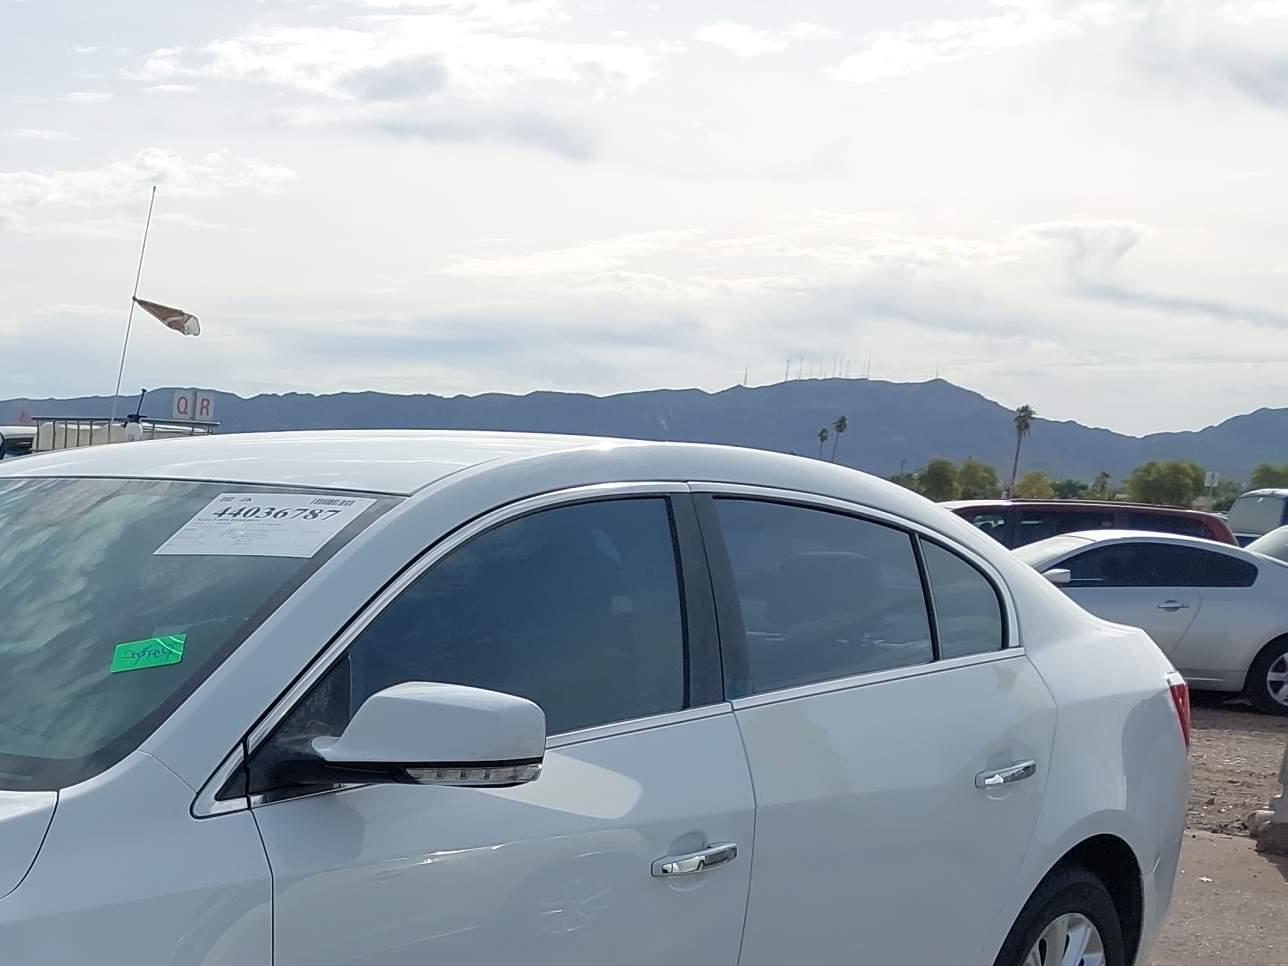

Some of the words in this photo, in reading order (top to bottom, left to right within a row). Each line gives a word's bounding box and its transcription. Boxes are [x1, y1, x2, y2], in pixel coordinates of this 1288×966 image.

[176, 396, 188, 415] Q
[199, 398, 210, 417] R
[212, 506, 343, 521] 44036787
